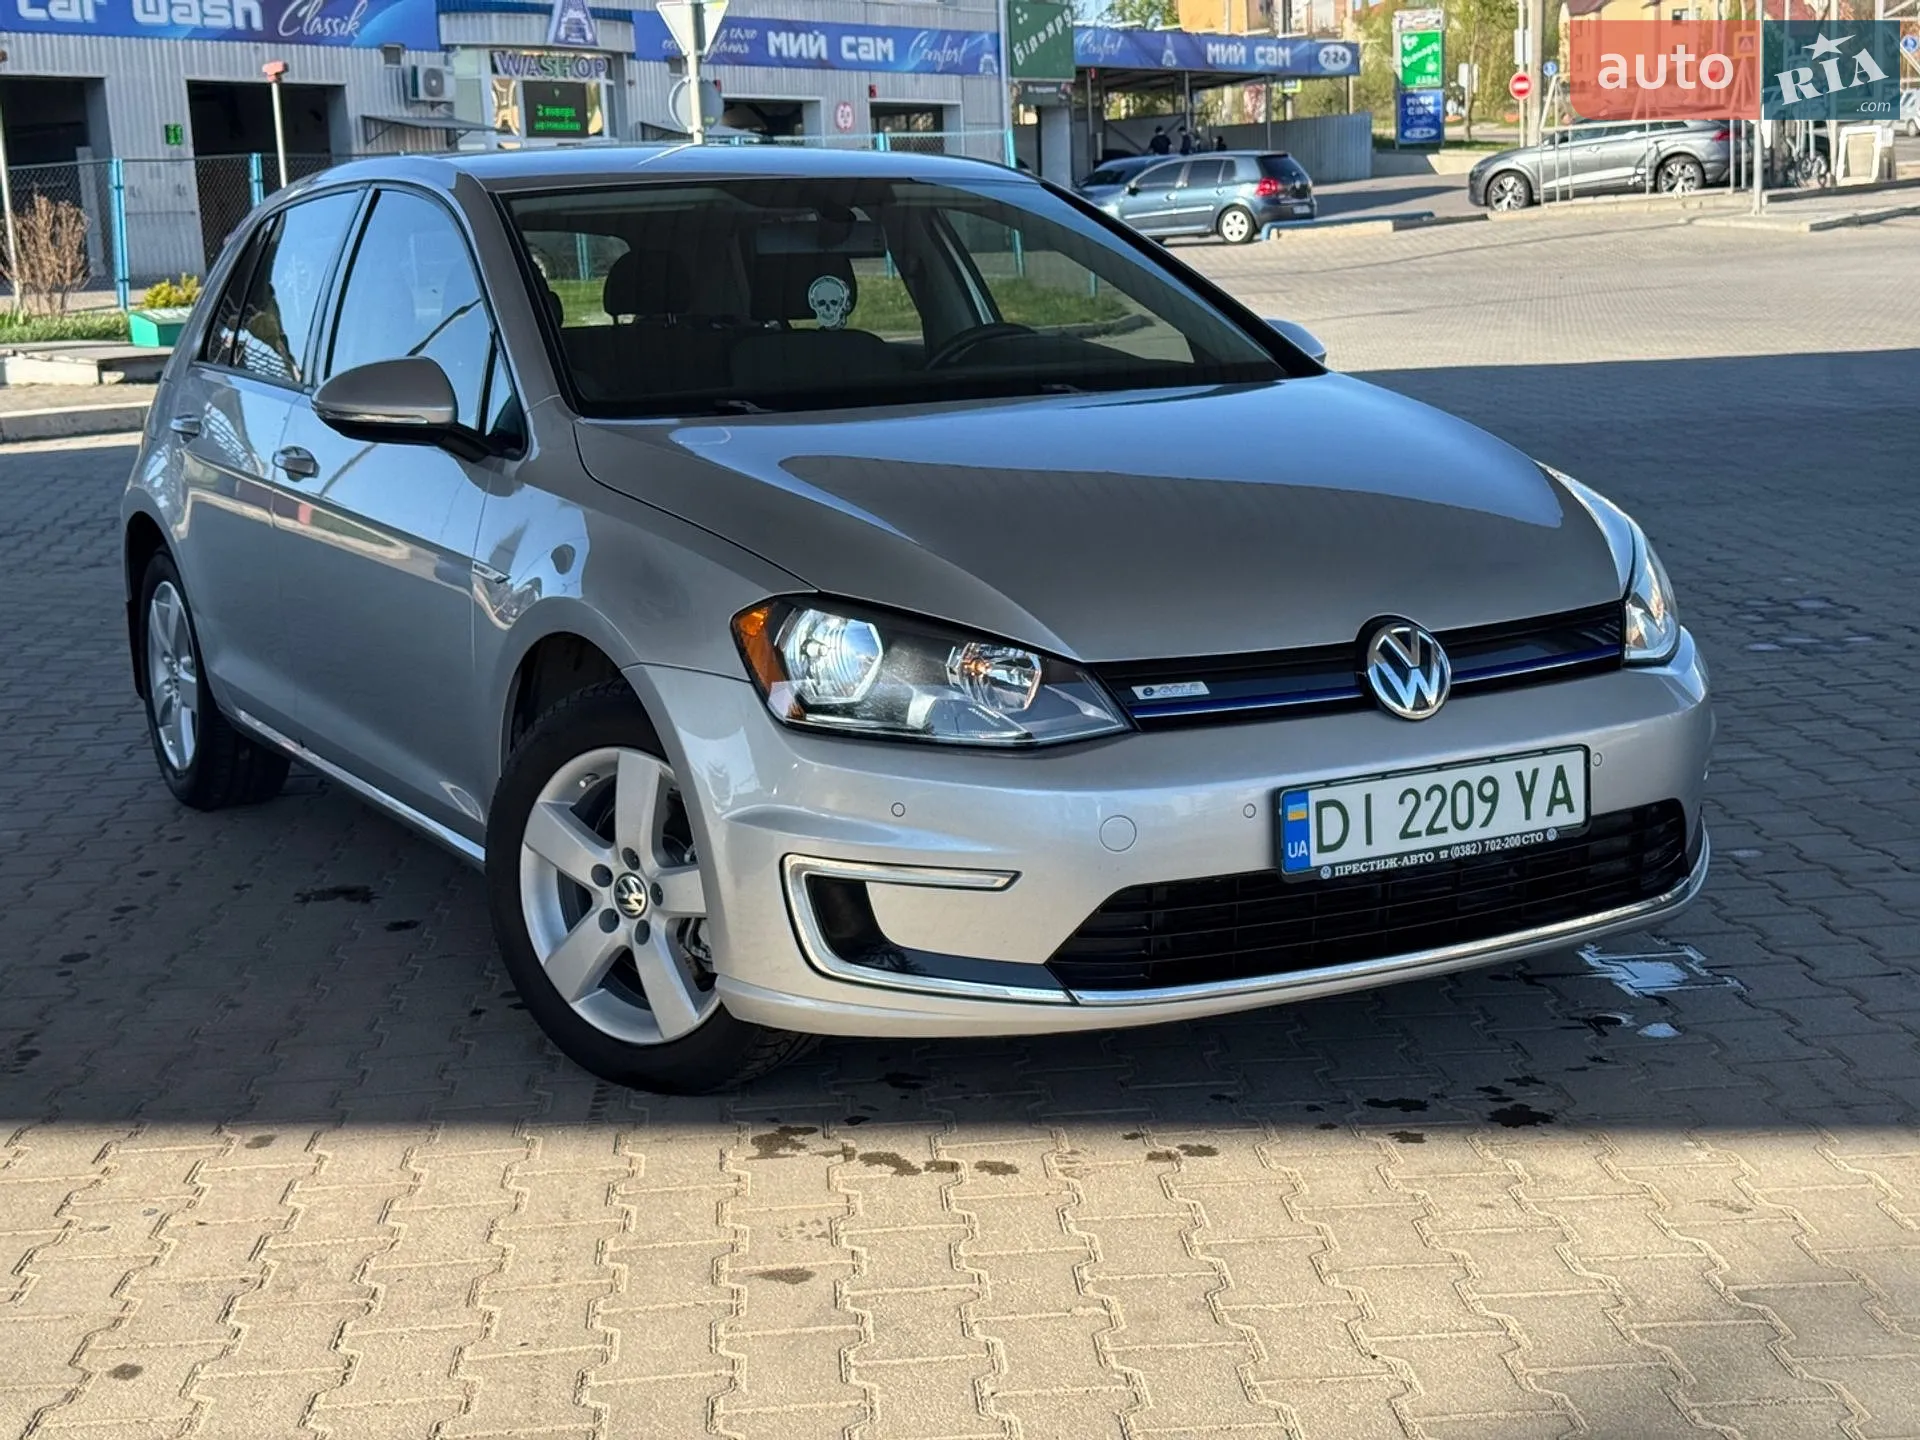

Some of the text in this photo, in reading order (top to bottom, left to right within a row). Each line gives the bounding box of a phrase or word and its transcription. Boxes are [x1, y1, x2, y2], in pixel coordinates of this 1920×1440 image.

[278, 0, 368, 37] Classik
[493, 51, 608, 78] WASHOP
[907, 30, 968, 71] Comfort
[1315, 764, 1575, 854] DI 2209 YA
[1287, 839, 1308, 858] UA
[1334, 851, 1435, 877] ПРЕСТИЖ-АВТО
[1450, 843, 1482, 859] (0382)
